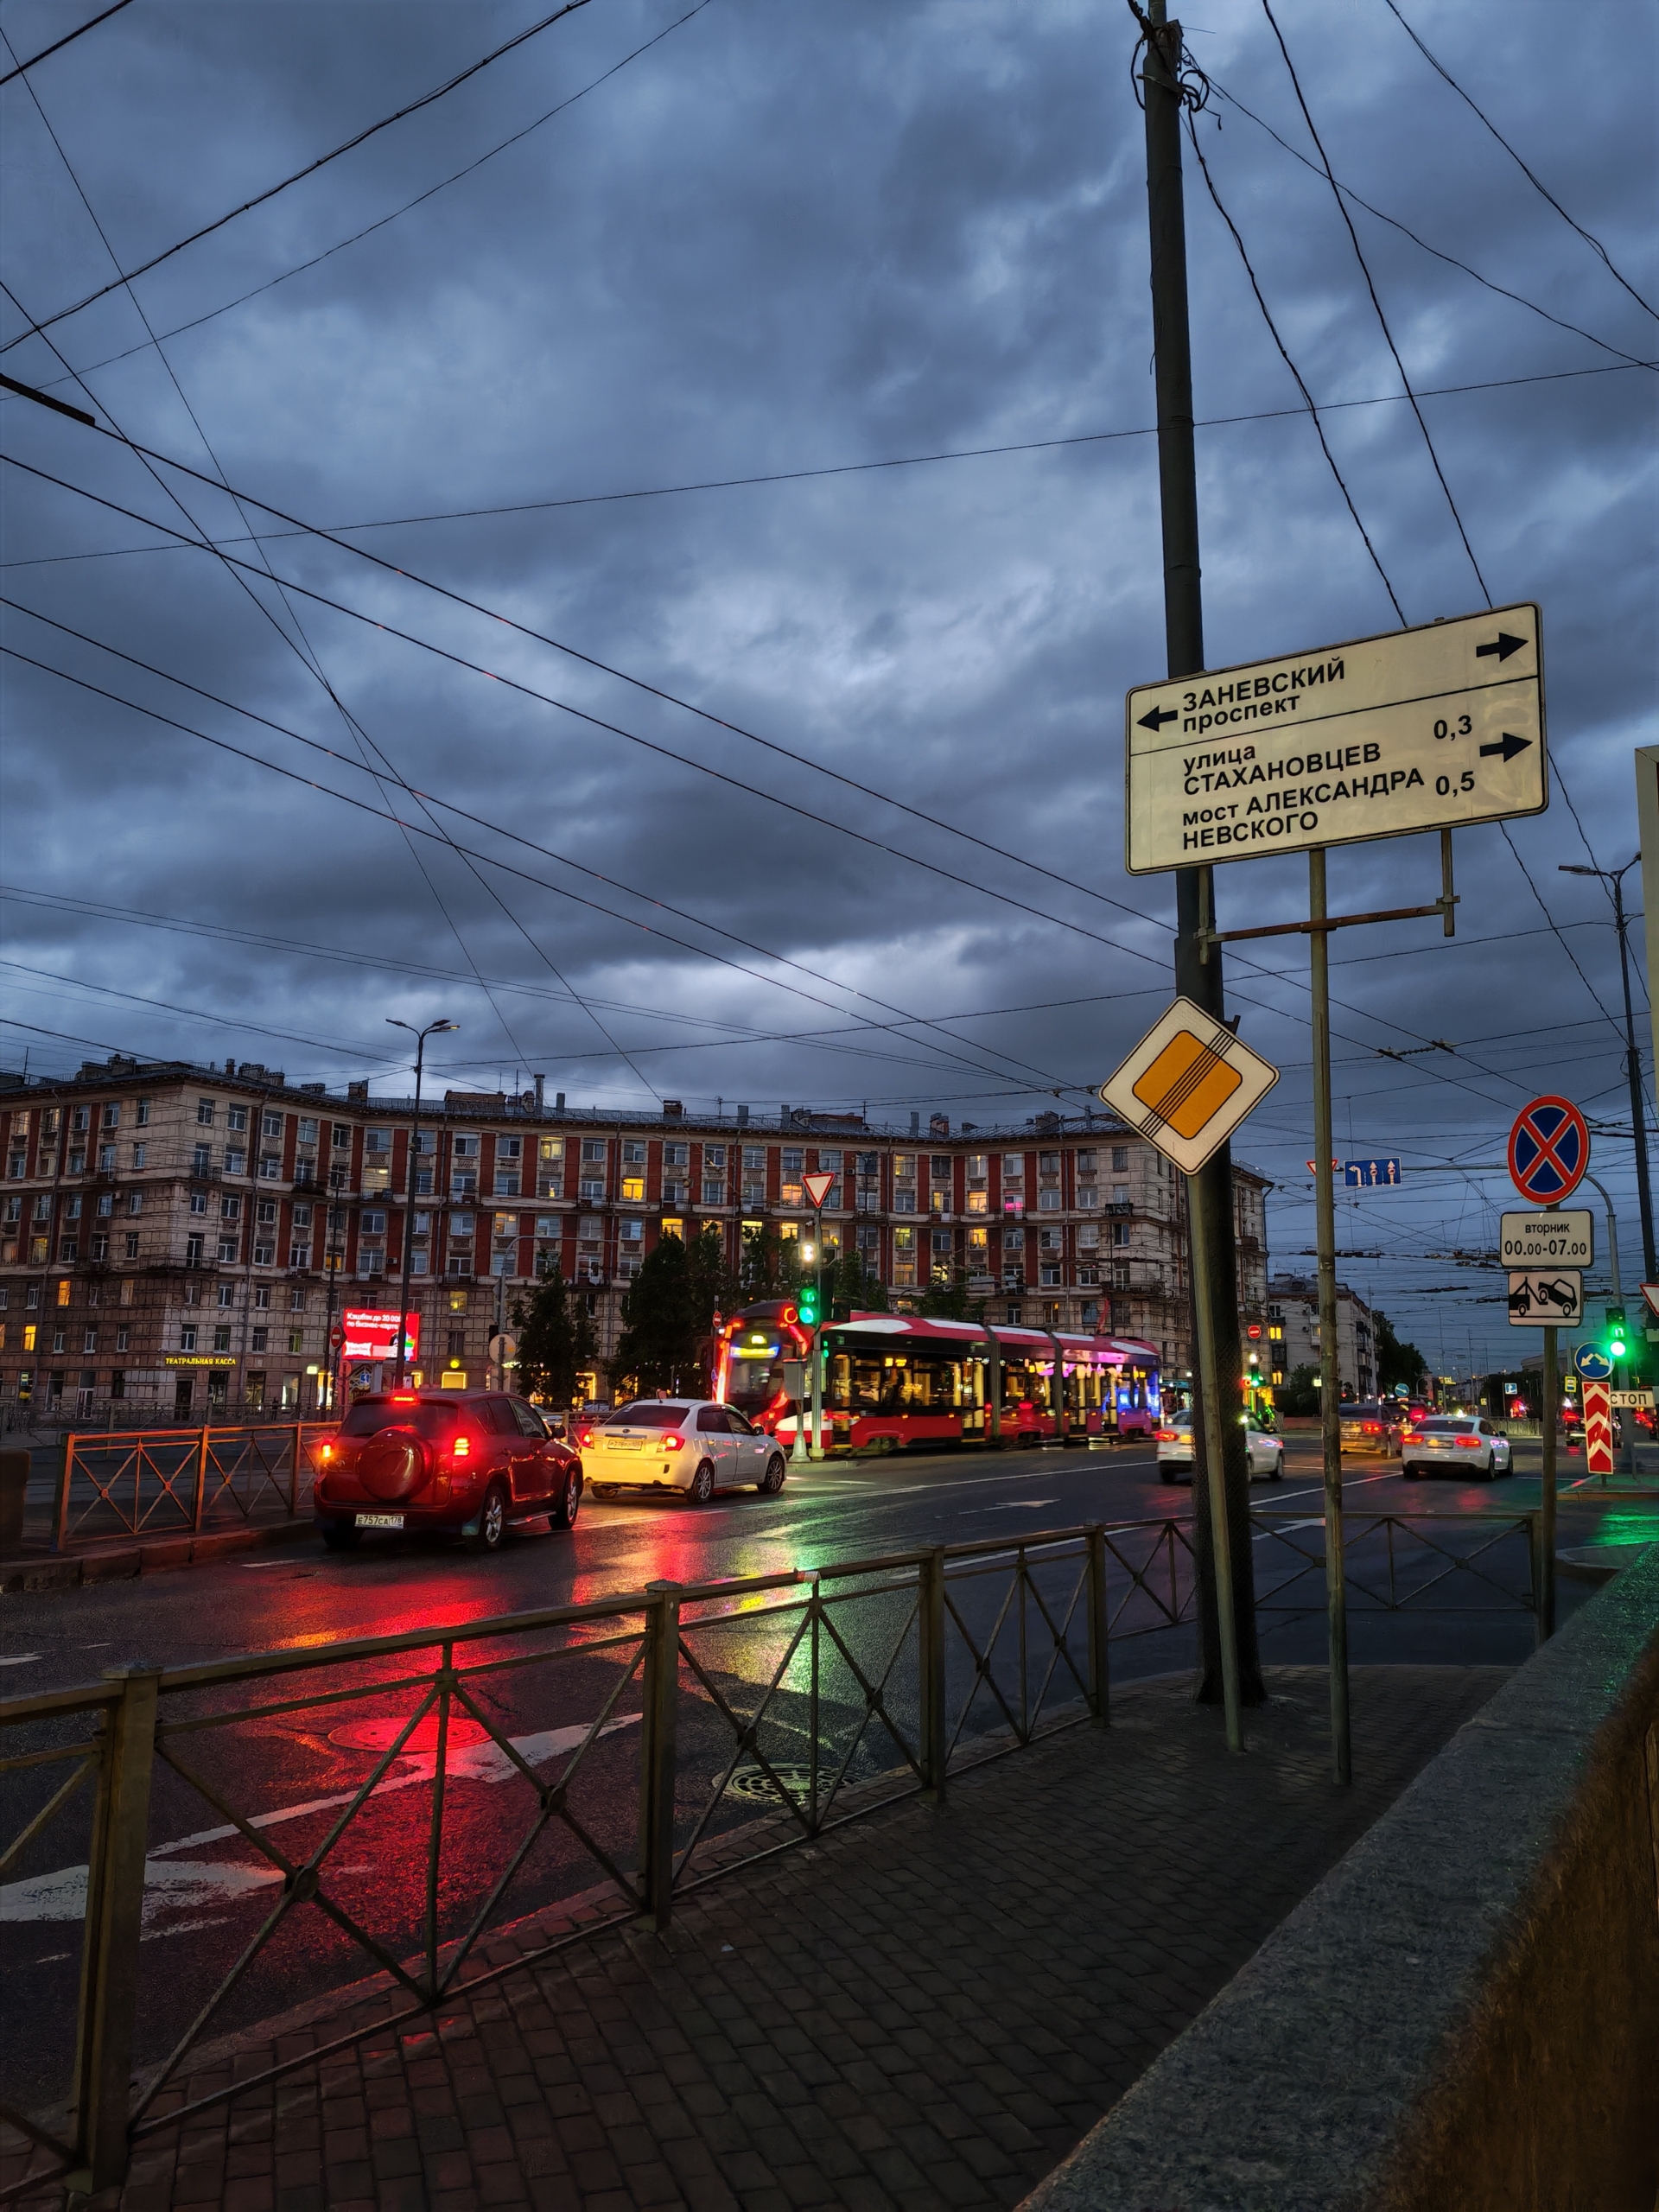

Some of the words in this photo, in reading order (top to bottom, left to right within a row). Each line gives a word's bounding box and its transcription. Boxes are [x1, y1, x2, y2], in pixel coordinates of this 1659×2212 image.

[1183, 657, 1344, 712] ЗАНЕВСКИЙ
[1184, 696, 1300, 734] проспект
[1433, 715, 1472, 741] 0,3
[1183, 747, 1256, 777] улица
[1184, 742, 1381, 796] СТАХАНОВЦЕВ
[1183, 804, 1239, 827] мост
[1246, 768, 1425, 816] АЛЕКСАНДРА
[1435, 771, 1475, 797] 0,5
[1183, 810, 1319, 850] НЕВСКОГО
[1525, 1224, 1570, 1236] вторник
[1504, 1239, 1586, 1255] 00.00-07.00
[1611, 1394, 1646, 1405] СТОП
